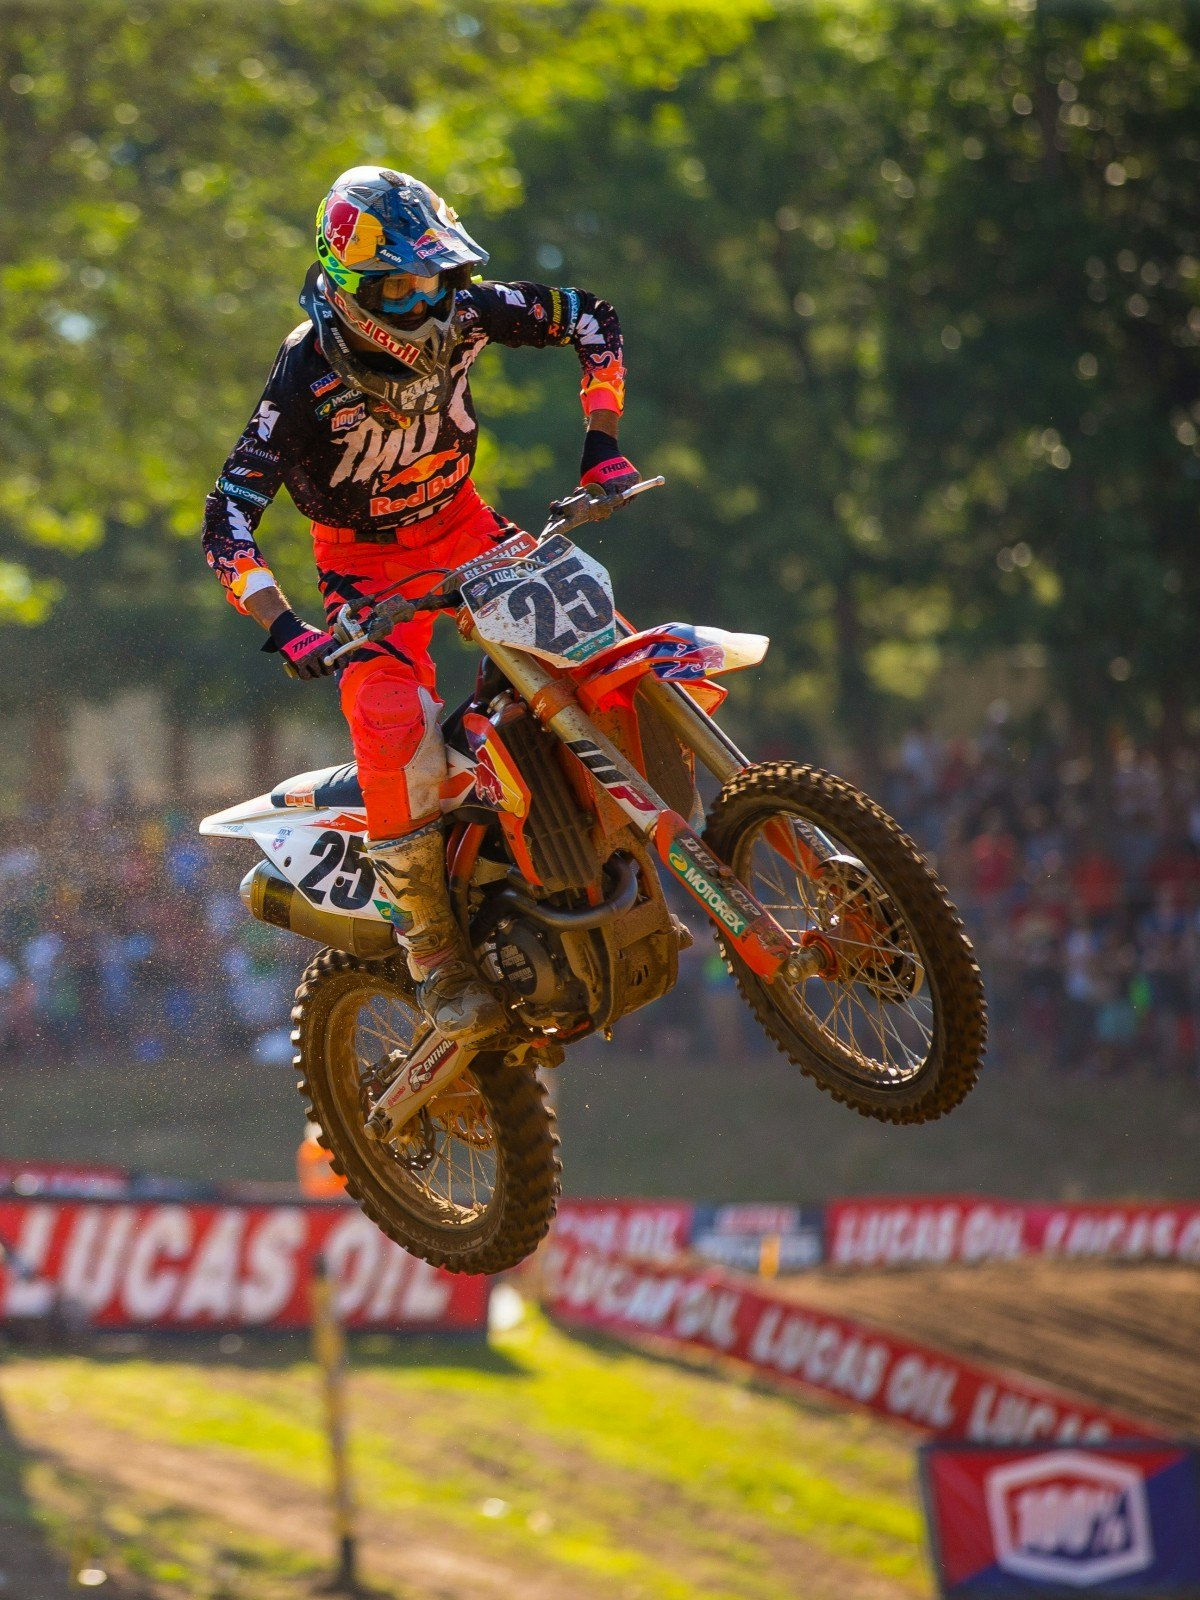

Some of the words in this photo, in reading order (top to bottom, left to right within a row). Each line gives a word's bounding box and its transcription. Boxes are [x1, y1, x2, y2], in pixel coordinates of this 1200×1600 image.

[371, 328, 421, 366] Bull
[370, 483, 426, 517] Red
[426, 452, 471, 501] Bull
[601, 460, 628, 475] THOR
[507, 556, 614, 654] 25
[297, 830, 377, 911] 25
[684, 867, 745, 933] MOTOREX
[409, 1039, 455, 1092] RENTHAL
[2, 1207, 309, 1321] LUCAS
[834, 1205, 960, 1265] LUCAS
[961, 1205, 1026, 1261] OIL
[750, 1303, 892, 1401] LUCAS
[886, 1354, 961, 1429] OIL
